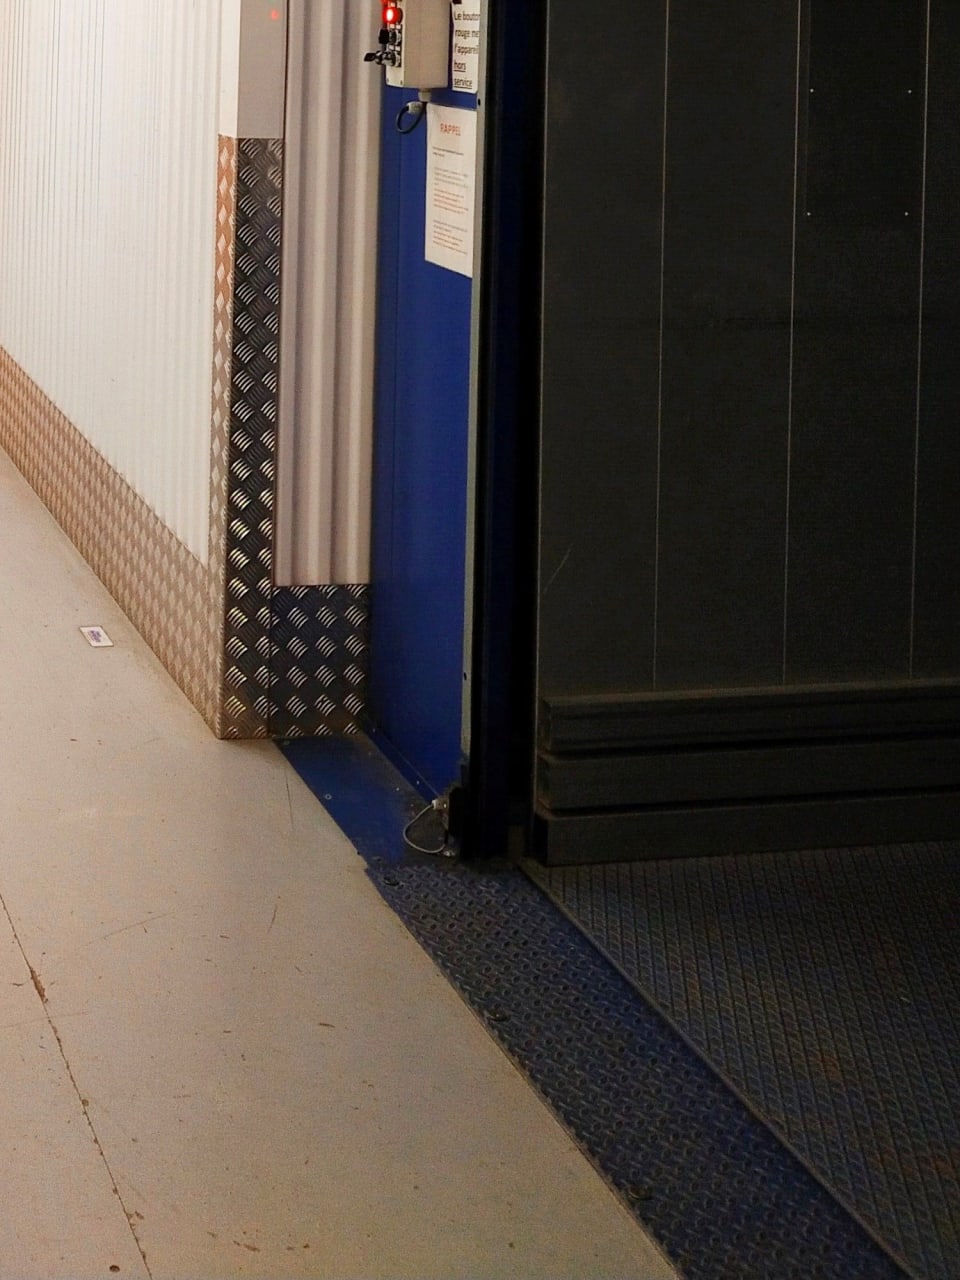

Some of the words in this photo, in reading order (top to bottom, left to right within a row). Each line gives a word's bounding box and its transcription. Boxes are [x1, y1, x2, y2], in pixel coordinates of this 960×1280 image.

[454, 11, 462, 21] Le
[455, 29, 470, 39] rouge
[454, 61, 466, 71] hors
[454, 78, 472, 88] service
[440, 122, 461, 137] RAPPEL
